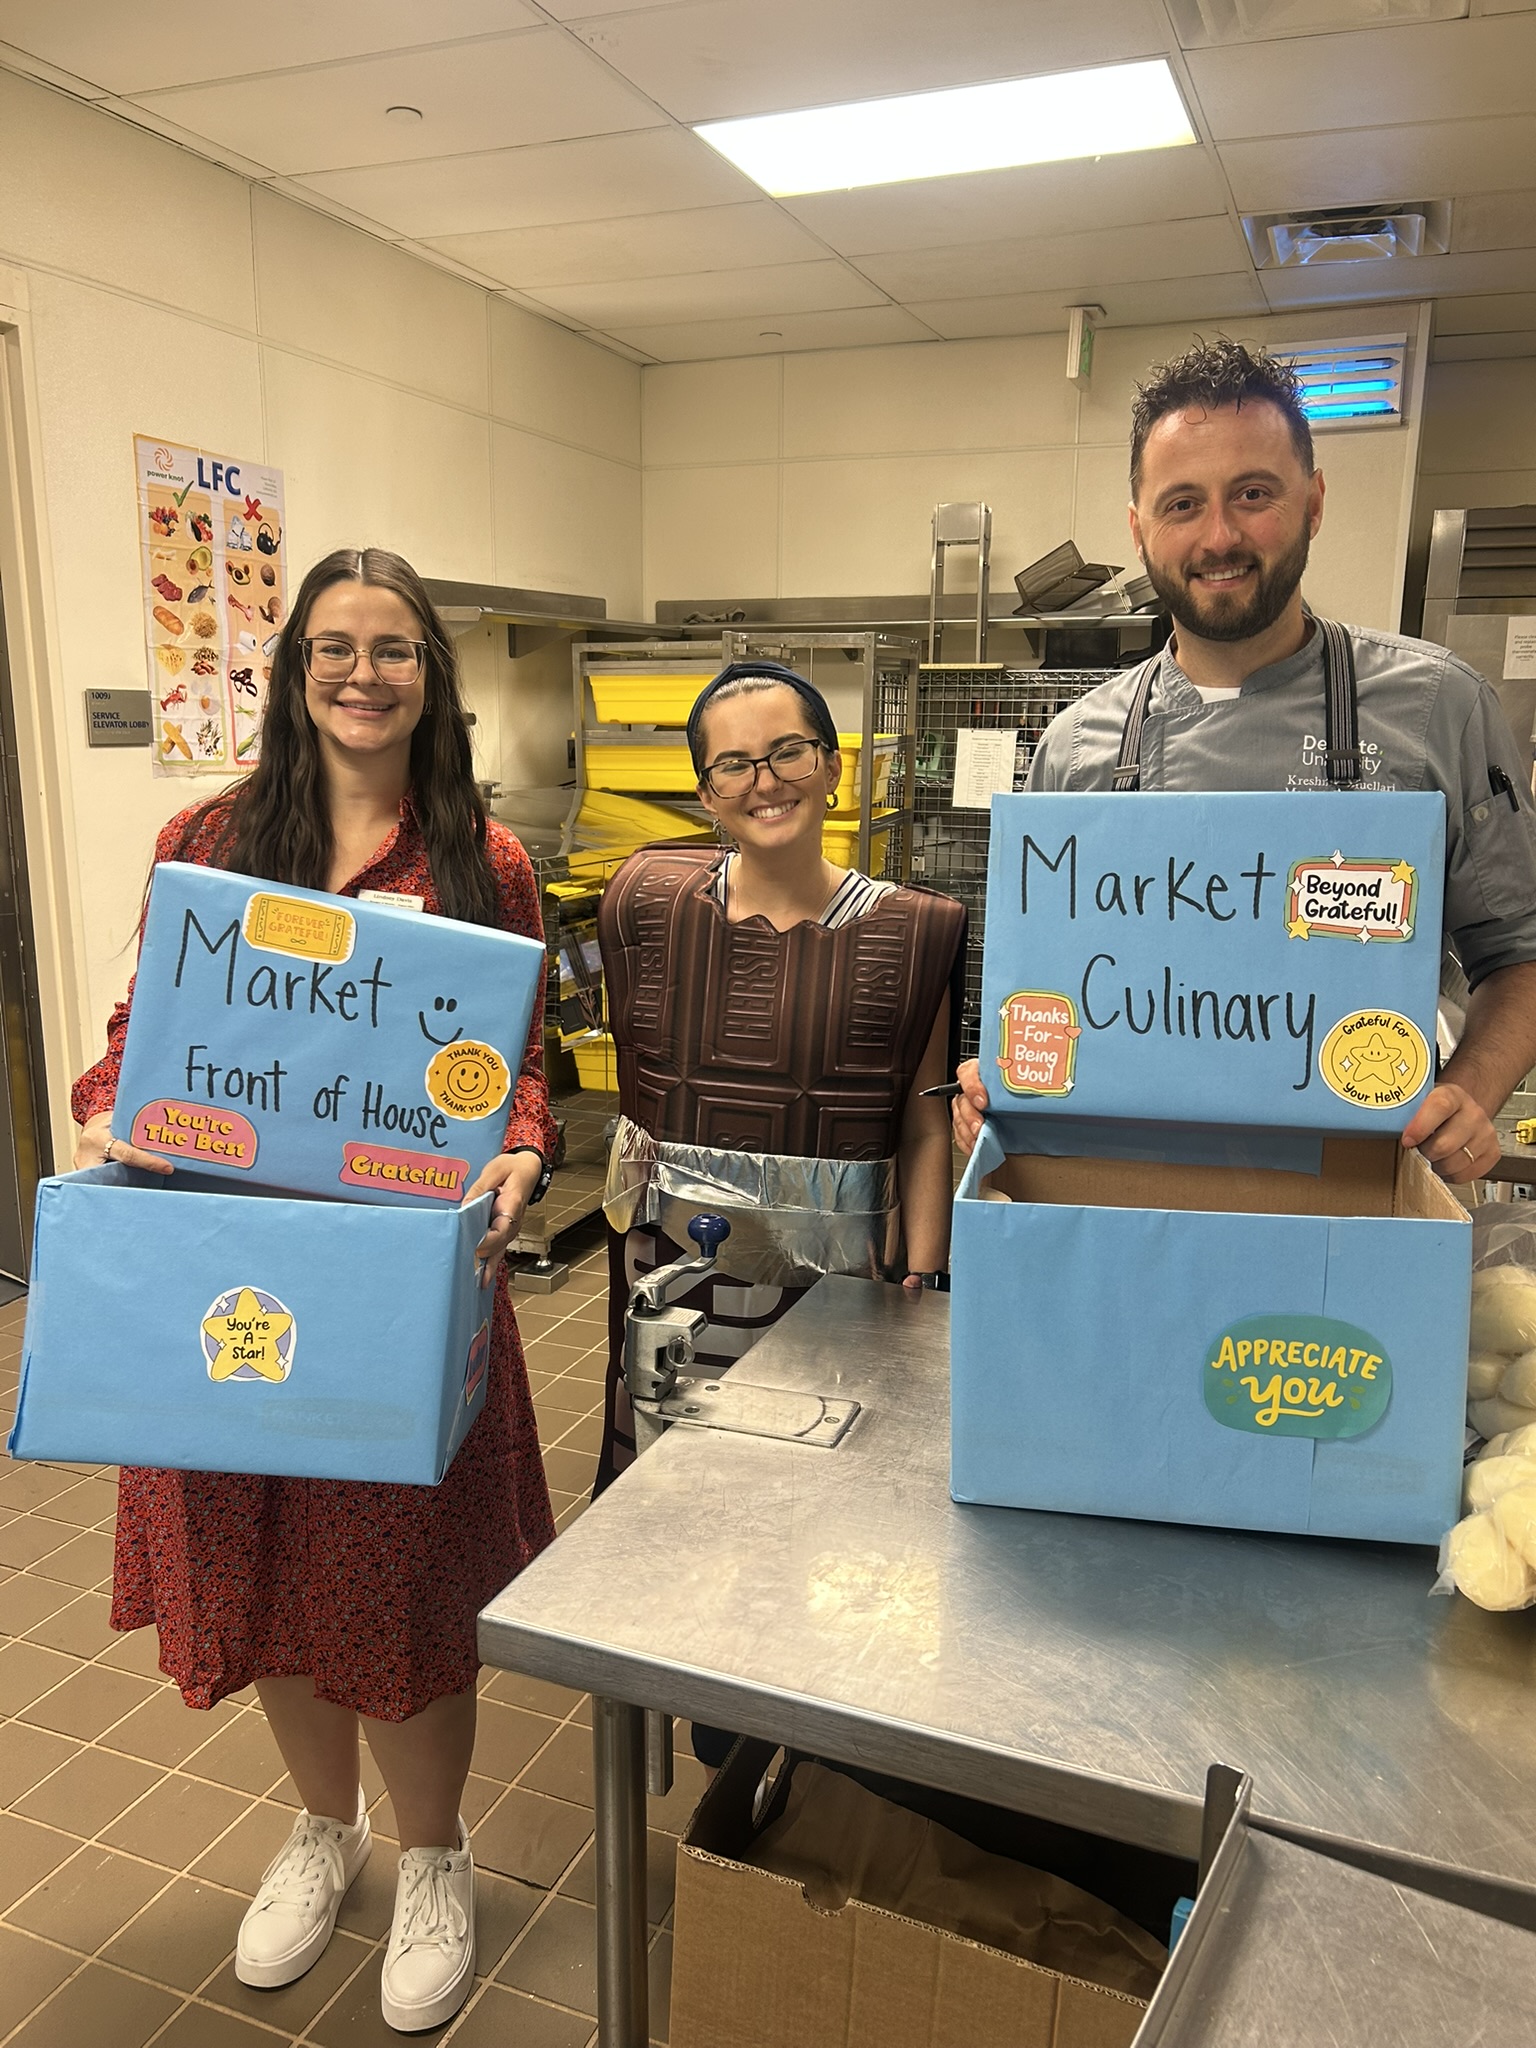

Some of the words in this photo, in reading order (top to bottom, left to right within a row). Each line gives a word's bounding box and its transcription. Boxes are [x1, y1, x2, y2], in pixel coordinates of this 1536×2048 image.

[147, 470, 168, 480] power
[168, 473, 184, 482] knot
[197, 457, 241, 496] LFC
[92, 711, 120, 720] SERVICE
[93, 720, 128, 728] ELEVATOR
[1021, 834, 1276, 922] Market
[1306, 874, 1383, 902] Beyond
[276, 912, 326, 930] FOREVER
[1304, 899, 1398, 924] Grateful!
[175, 908, 392, 1028] Market
[1010, 1004, 1069, 1025] Thanks
[1081, 953, 1316, 1091] Culinary
[1342, 1014, 1391, 1035] Grateful
[1392, 1021, 1410, 1039] For
[446, 1048, 482, 1061] THANK
[483, 1052, 500, 1071] YOU
[1014, 1044, 1059, 1069] Being
[1016, 1064, 1054, 1085] You!
[185, 1045, 288, 1112] Front
[313, 1075, 350, 1122] of
[362, 1081, 448, 1148] House
[439, 1090, 468, 1113] THANK
[468, 1100, 489, 1113] YOU
[1375, 1085, 1406, 1103] Help!
[163, 1106, 234, 1135] You're
[144, 1123, 189, 1147] The
[194, 1133, 246, 1158] Best
[350, 1154, 459, 1190] Grateful
[226, 1317, 271, 1331] You're
[232, 1346, 265, 1360] Star!
[1211, 1336, 1384, 1380] APPRECIATE
